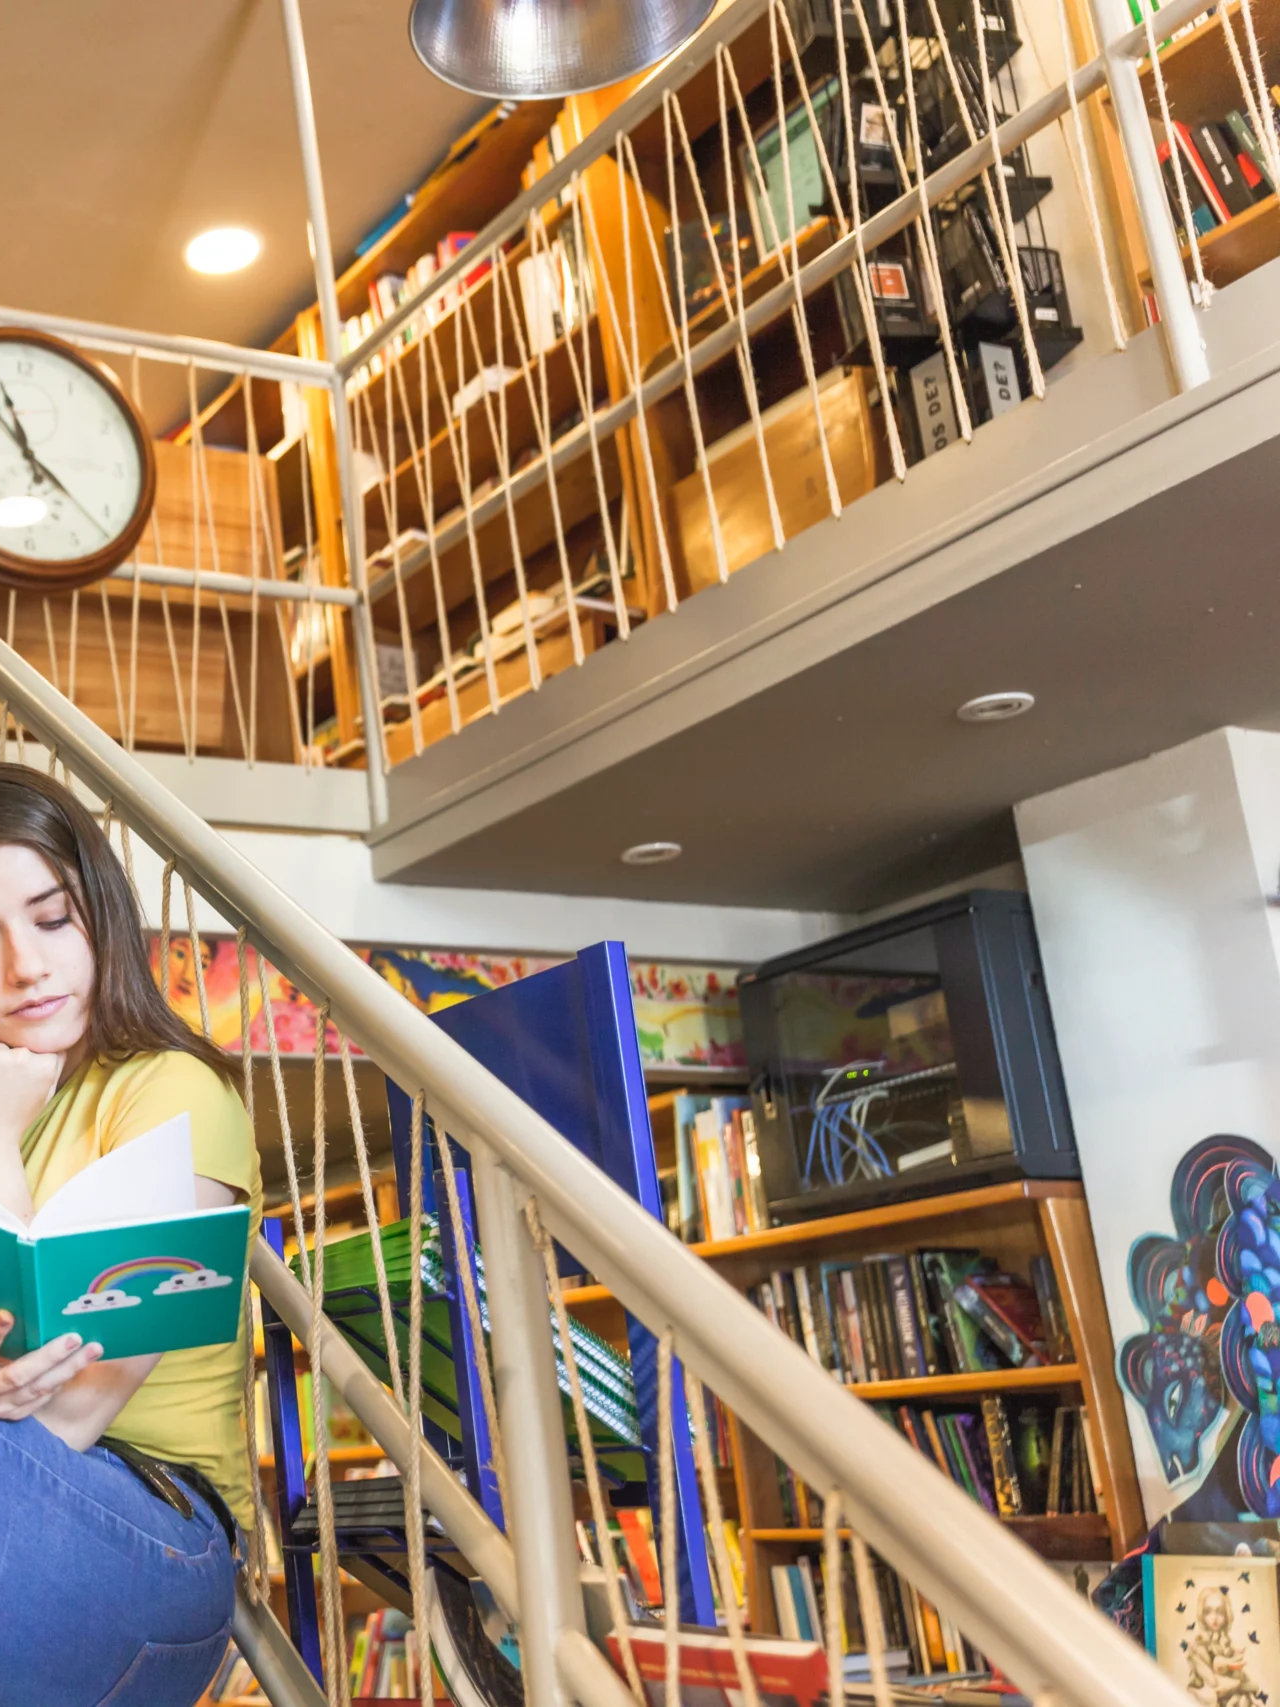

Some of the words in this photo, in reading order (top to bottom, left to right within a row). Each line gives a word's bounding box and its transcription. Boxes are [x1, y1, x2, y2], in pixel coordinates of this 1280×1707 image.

[17, 360, 34, 378] 12
[993, 361, 1011, 400] DE?
[924, 376, 941, 416] DE?
[101, 420, 111, 436] 2
[112, 462, 125, 480] 3
[24, 537, 37, 552] 6
[70, 531, 81, 548] 5
